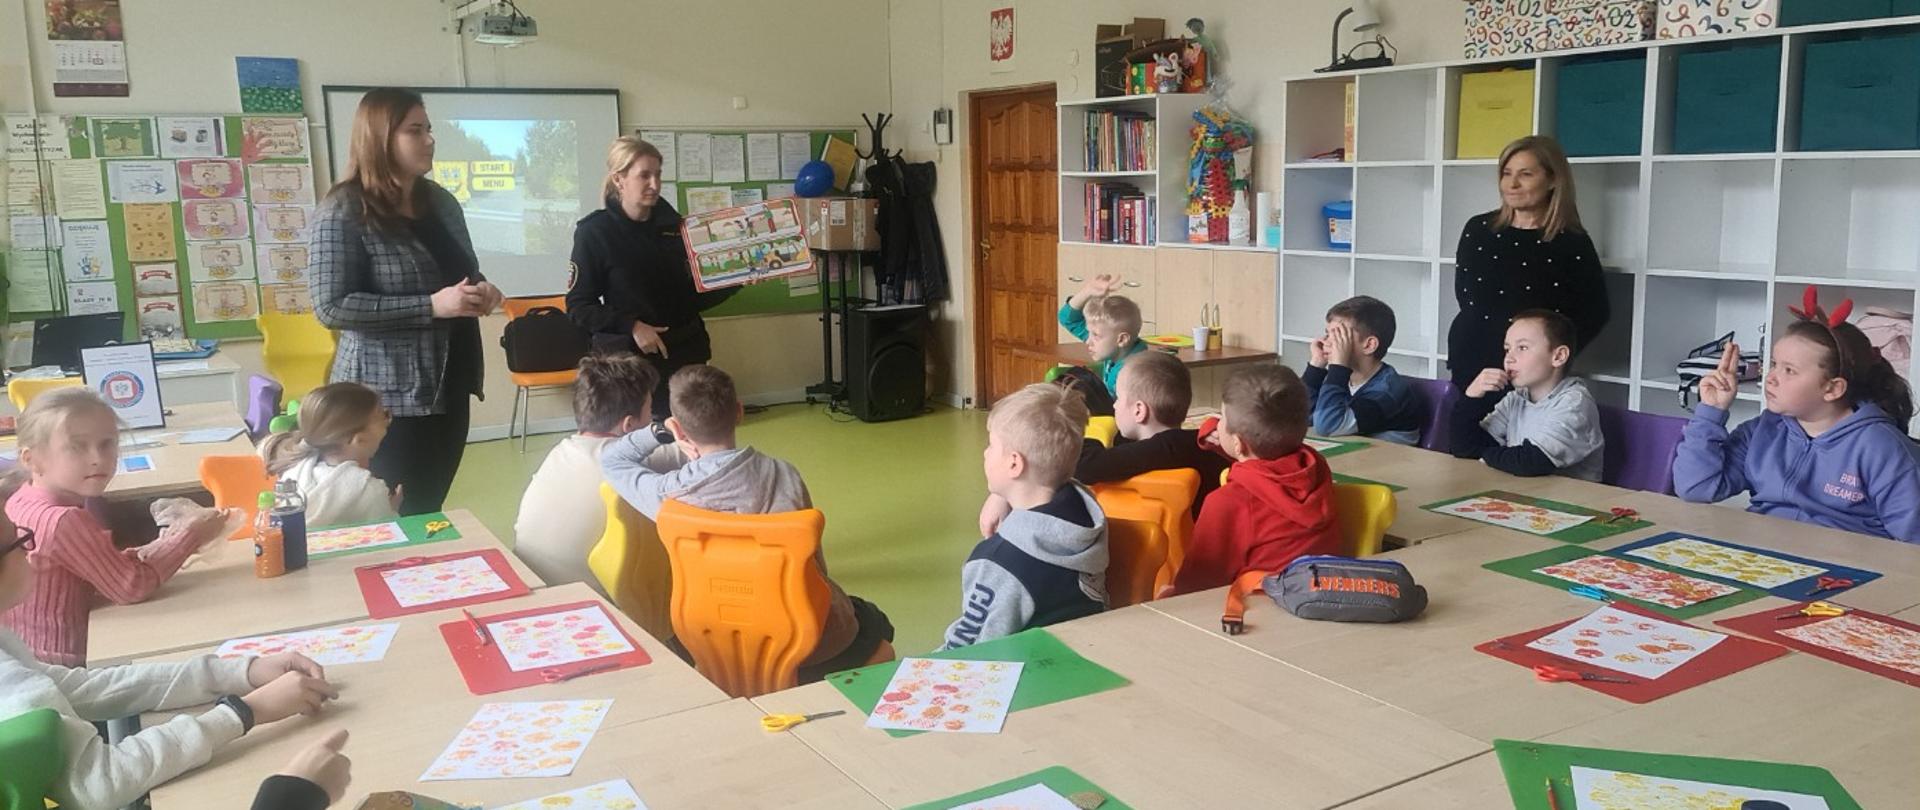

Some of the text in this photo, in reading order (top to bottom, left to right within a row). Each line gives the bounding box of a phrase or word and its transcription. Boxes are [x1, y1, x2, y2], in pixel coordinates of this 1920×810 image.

[480, 163, 505, 173] START
[483, 179, 505, 188] MENU
[1840, 473, 1858, 488] BRA
